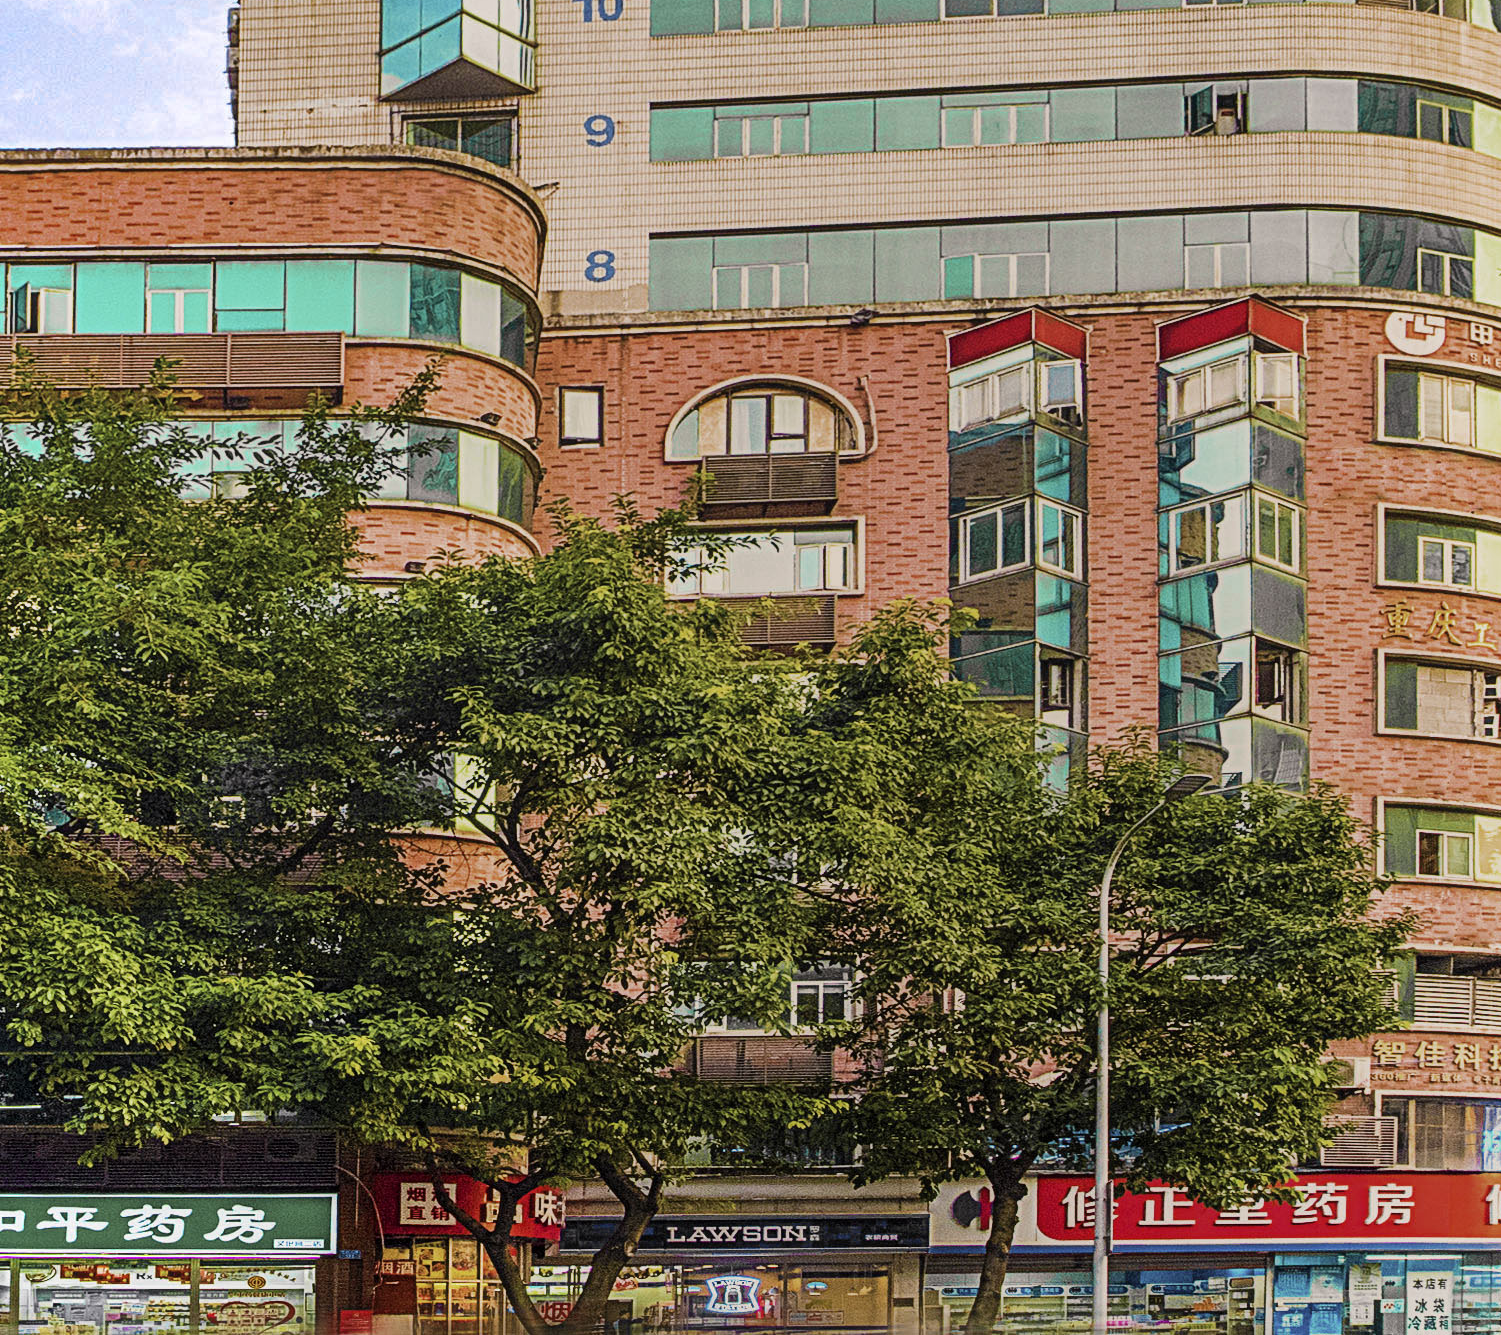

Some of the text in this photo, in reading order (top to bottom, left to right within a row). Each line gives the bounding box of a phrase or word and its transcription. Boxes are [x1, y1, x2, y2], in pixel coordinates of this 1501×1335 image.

[584, 114, 616, 147] 9
[583, 249, 617, 283] 8
[407, 1205, 450, 1221] 直销
[667, 1225, 807, 1242] LAWSON
[1412, 1278, 1448, 1290] 本店有
[1414, 1298, 1446, 1313] 冰袋
[1407, 1315, 1450, 1331] 冷藏箱
